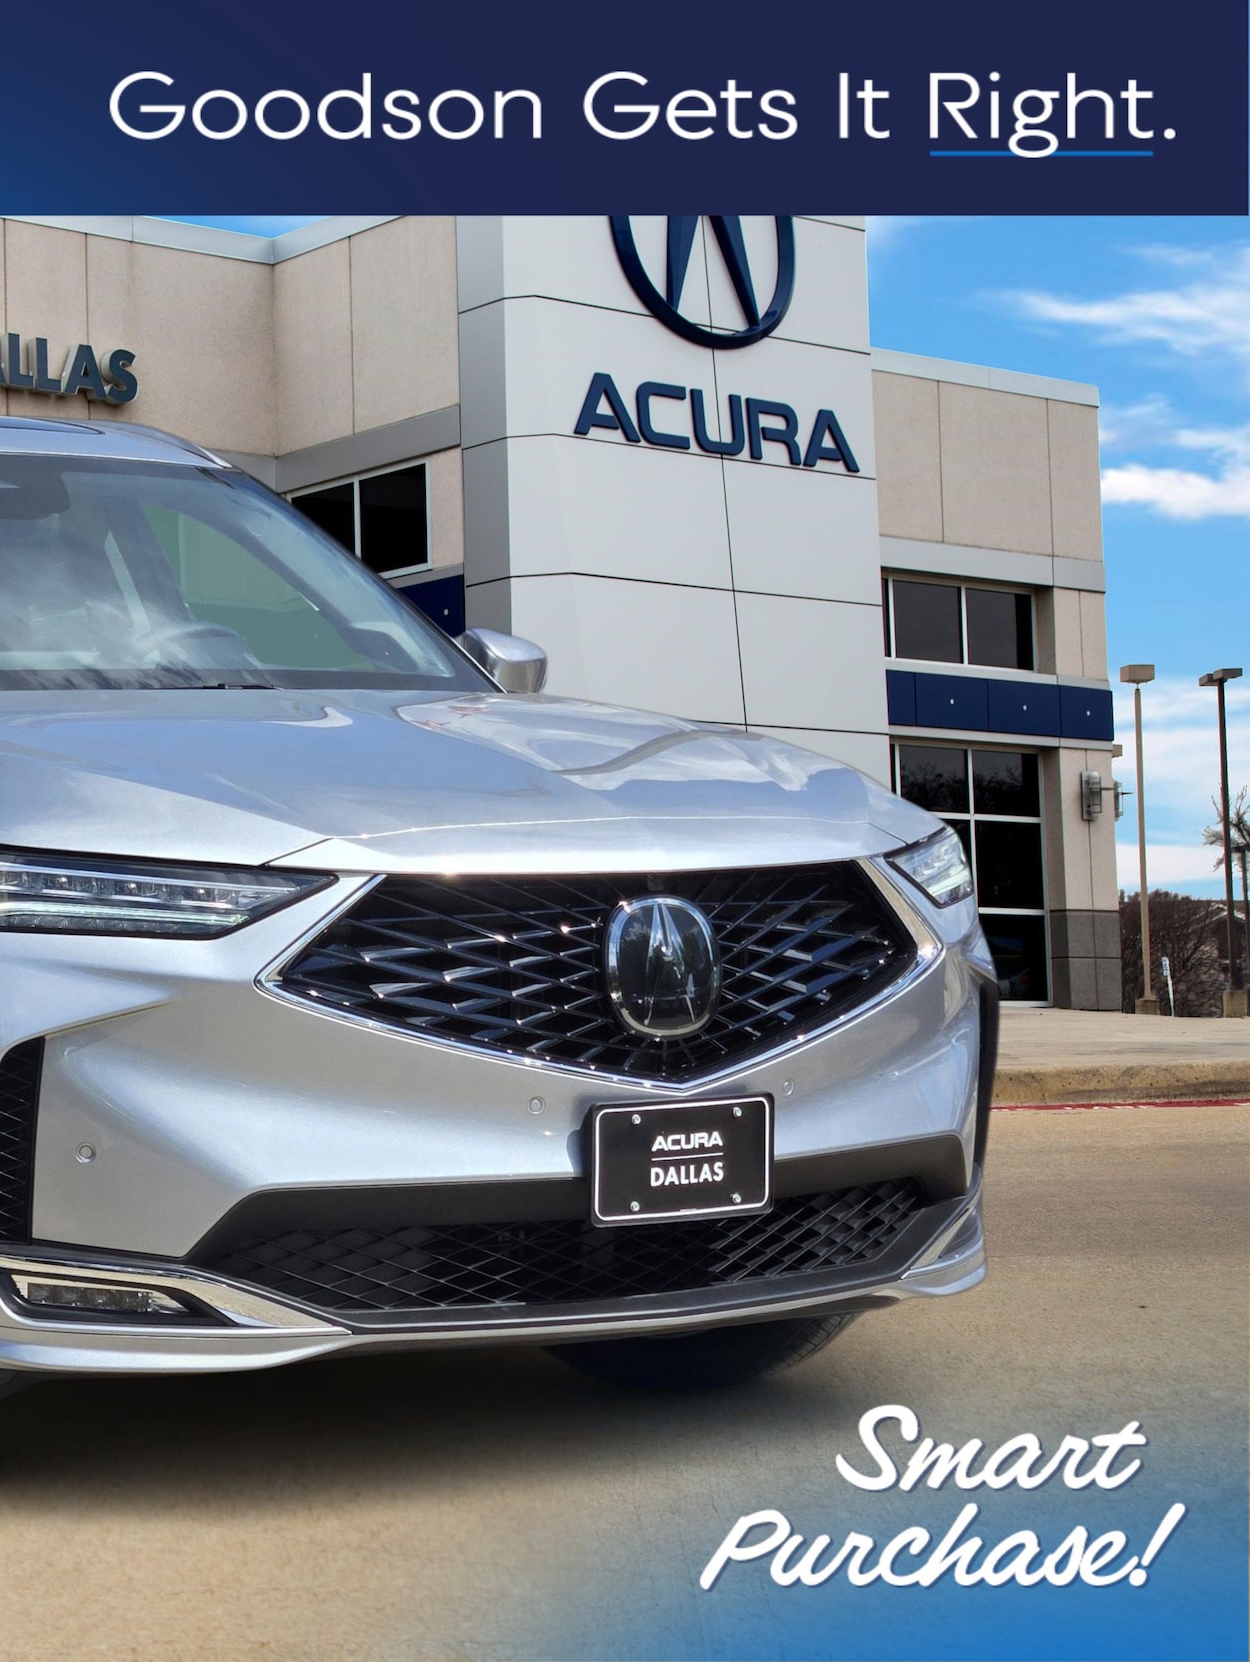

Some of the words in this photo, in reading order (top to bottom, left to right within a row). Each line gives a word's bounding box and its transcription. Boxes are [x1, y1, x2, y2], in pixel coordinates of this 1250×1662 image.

[573, 372, 861, 473] ACURA
[651, 1131, 724, 1152] ACURA
[650, 1161, 724, 1187] DALLAS
